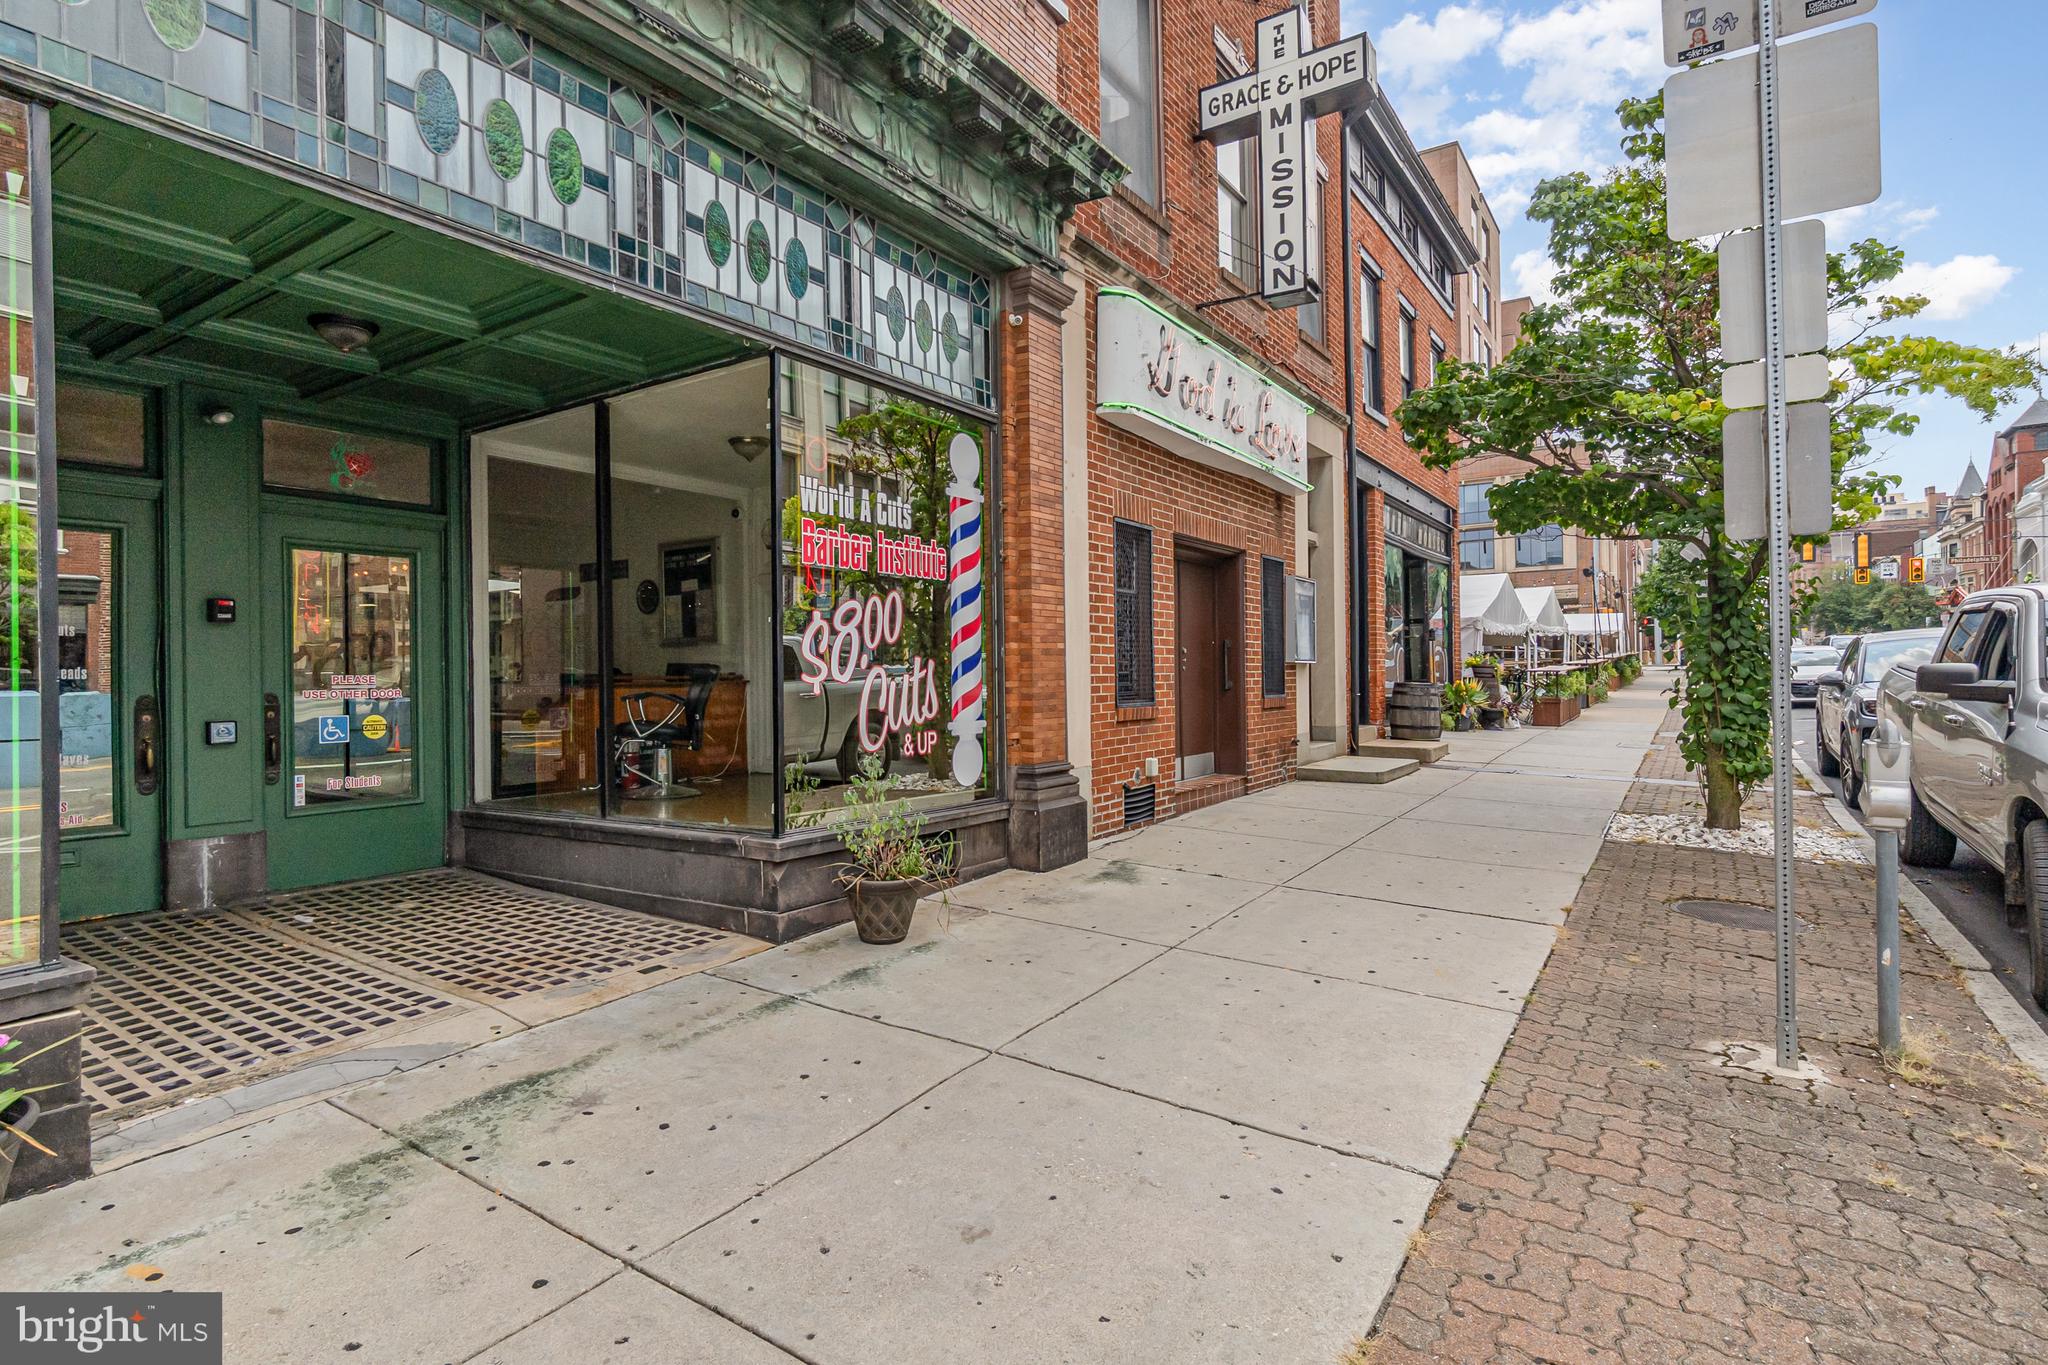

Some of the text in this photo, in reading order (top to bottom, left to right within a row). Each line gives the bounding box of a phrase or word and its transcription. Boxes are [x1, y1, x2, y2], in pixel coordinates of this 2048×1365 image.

[1272, 22, 1285, 60] THE
[1208, 50, 1357, 117] GRACE & HOPE
[1269, 102, 1296, 290] MISSION
[1147, 325, 1221, 422] God
[1223, 376, 1247, 433] is
[799, 474, 913, 530] World A Cuts
[801, 517, 948, 581] Barber Institute
[57, 625, 76, 637] uts
[801, 589, 904, 697] $8.00
[60, 667, 88, 681] eads
[331, 675, 376, 685] PLEASE
[303, 688, 402, 700] USE OTHER DOOR
[858, 655, 940, 754] Cuts
[362, 724, 387, 733] CAUTION
[903, 730, 938, 757] & UP
[327, 774, 382, 791] For Students
